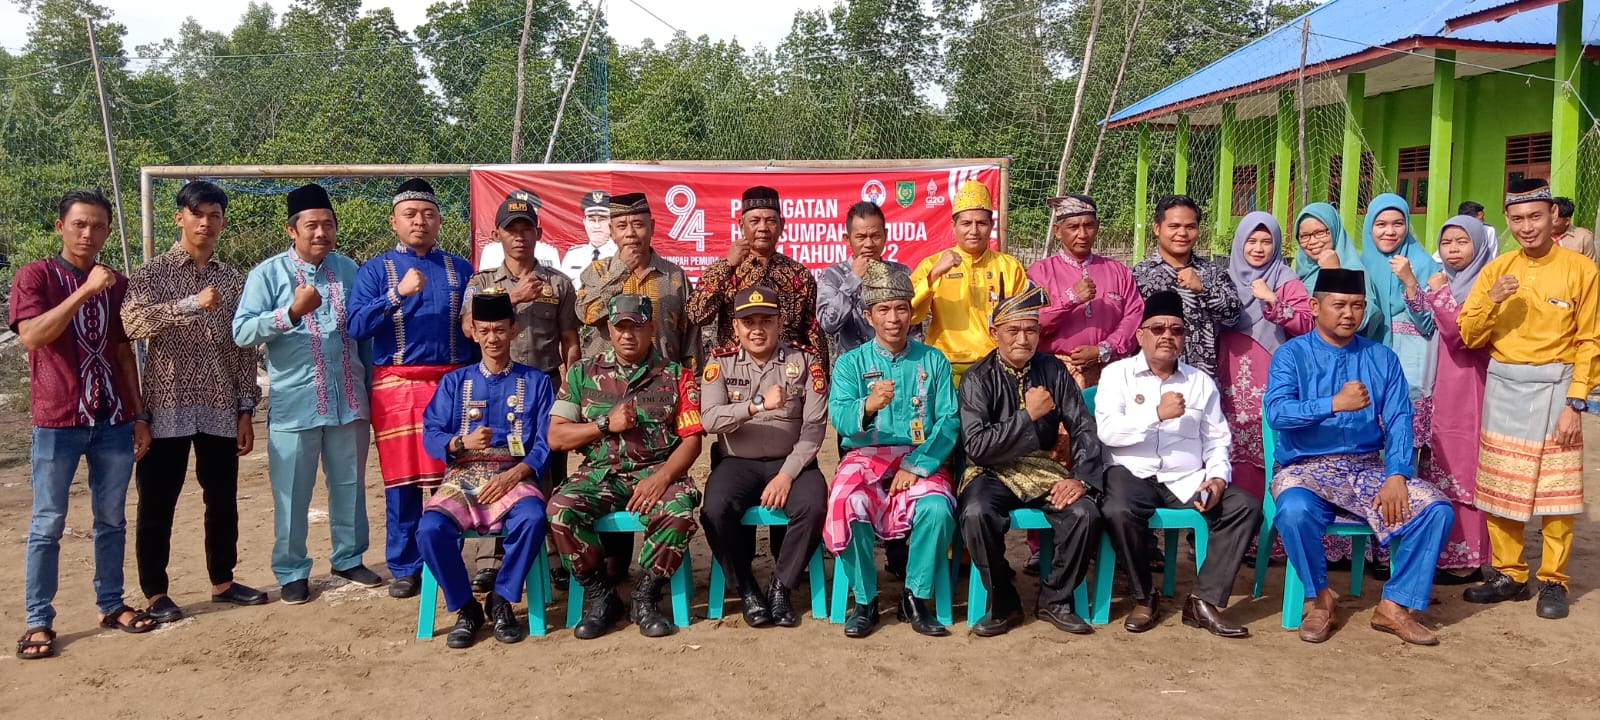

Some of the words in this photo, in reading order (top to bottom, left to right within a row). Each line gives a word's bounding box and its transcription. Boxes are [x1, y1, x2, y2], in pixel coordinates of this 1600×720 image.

[665, 184, 714, 252] 94
[731, 199, 838, 219] PGATAN
[789, 243, 847, 264] TAHUN
